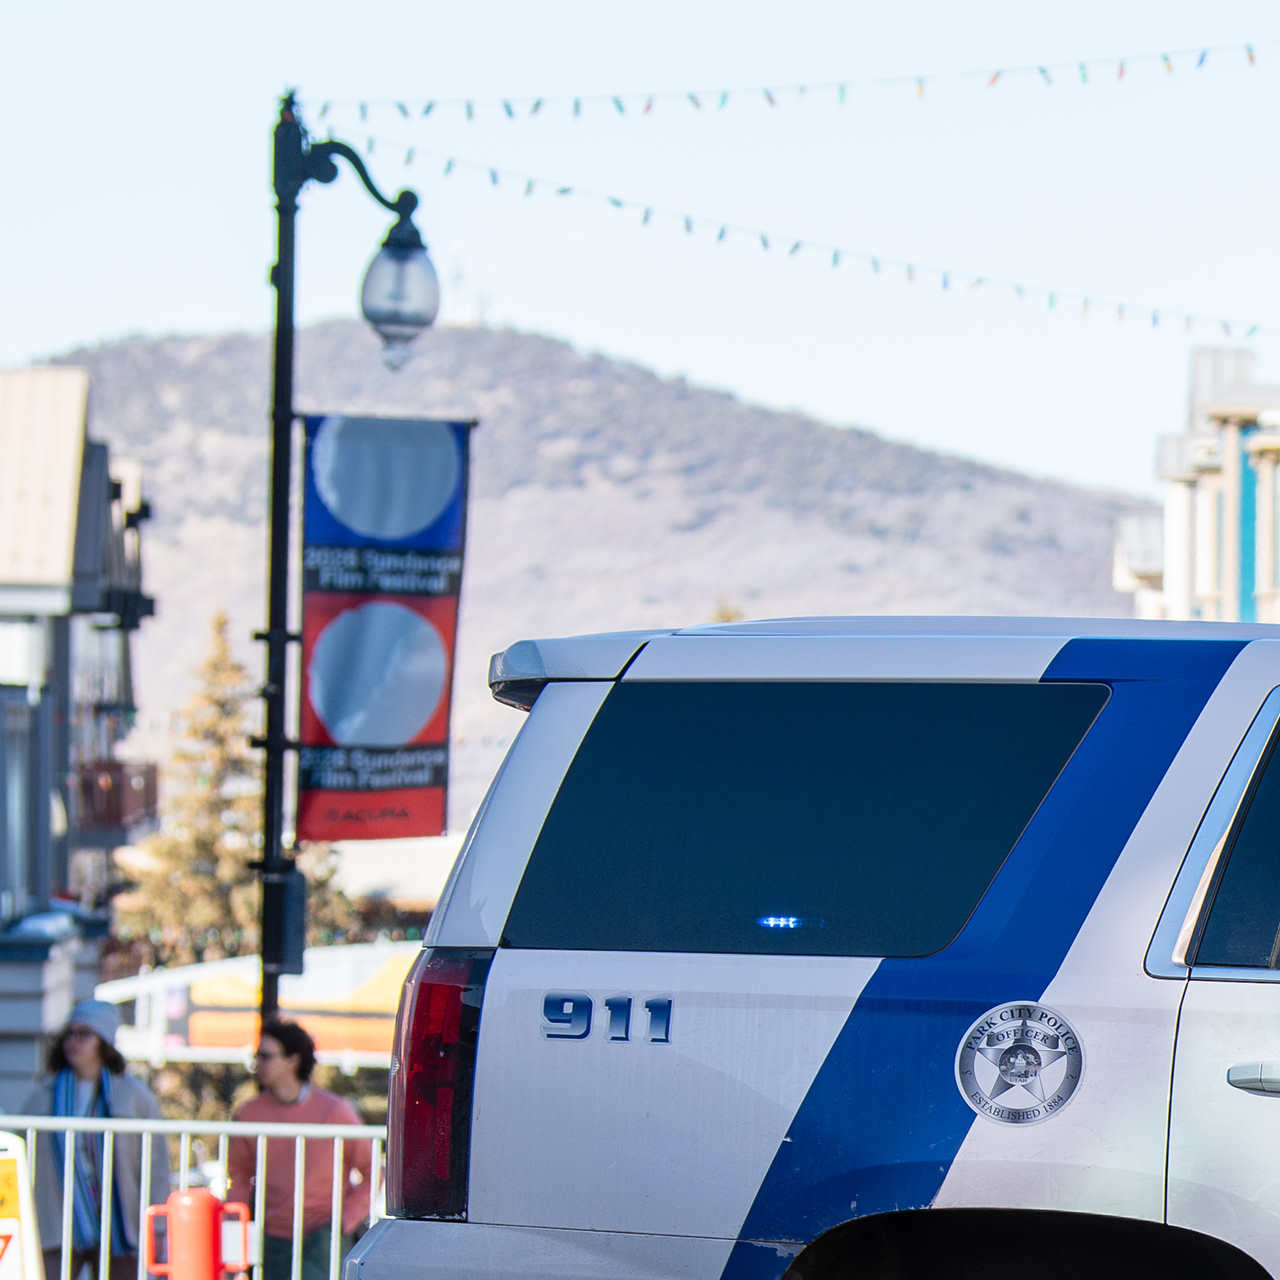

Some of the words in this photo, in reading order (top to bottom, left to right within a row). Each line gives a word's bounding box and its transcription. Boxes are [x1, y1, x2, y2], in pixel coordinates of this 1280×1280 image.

[361, 549, 461, 573] Sundance
[319, 568, 363, 589] Film
[367, 569, 445, 593] Festival
[349, 747, 445, 768] Sundance
[310, 766, 356, 788] Film
[357, 765, 430, 788] Festival
[541, 989, 674, 1044] 911
[965, 1016, 998, 1051] PARK
[999, 1007, 1036, 1022] CITY
[1038, 1010, 1079, 1056] POLICE
[995, 1028, 1049, 1045] OFFICER
[970, 1091, 1041, 1121] ESTABLISHED
[1042, 1094, 1065, 1114] 1884
